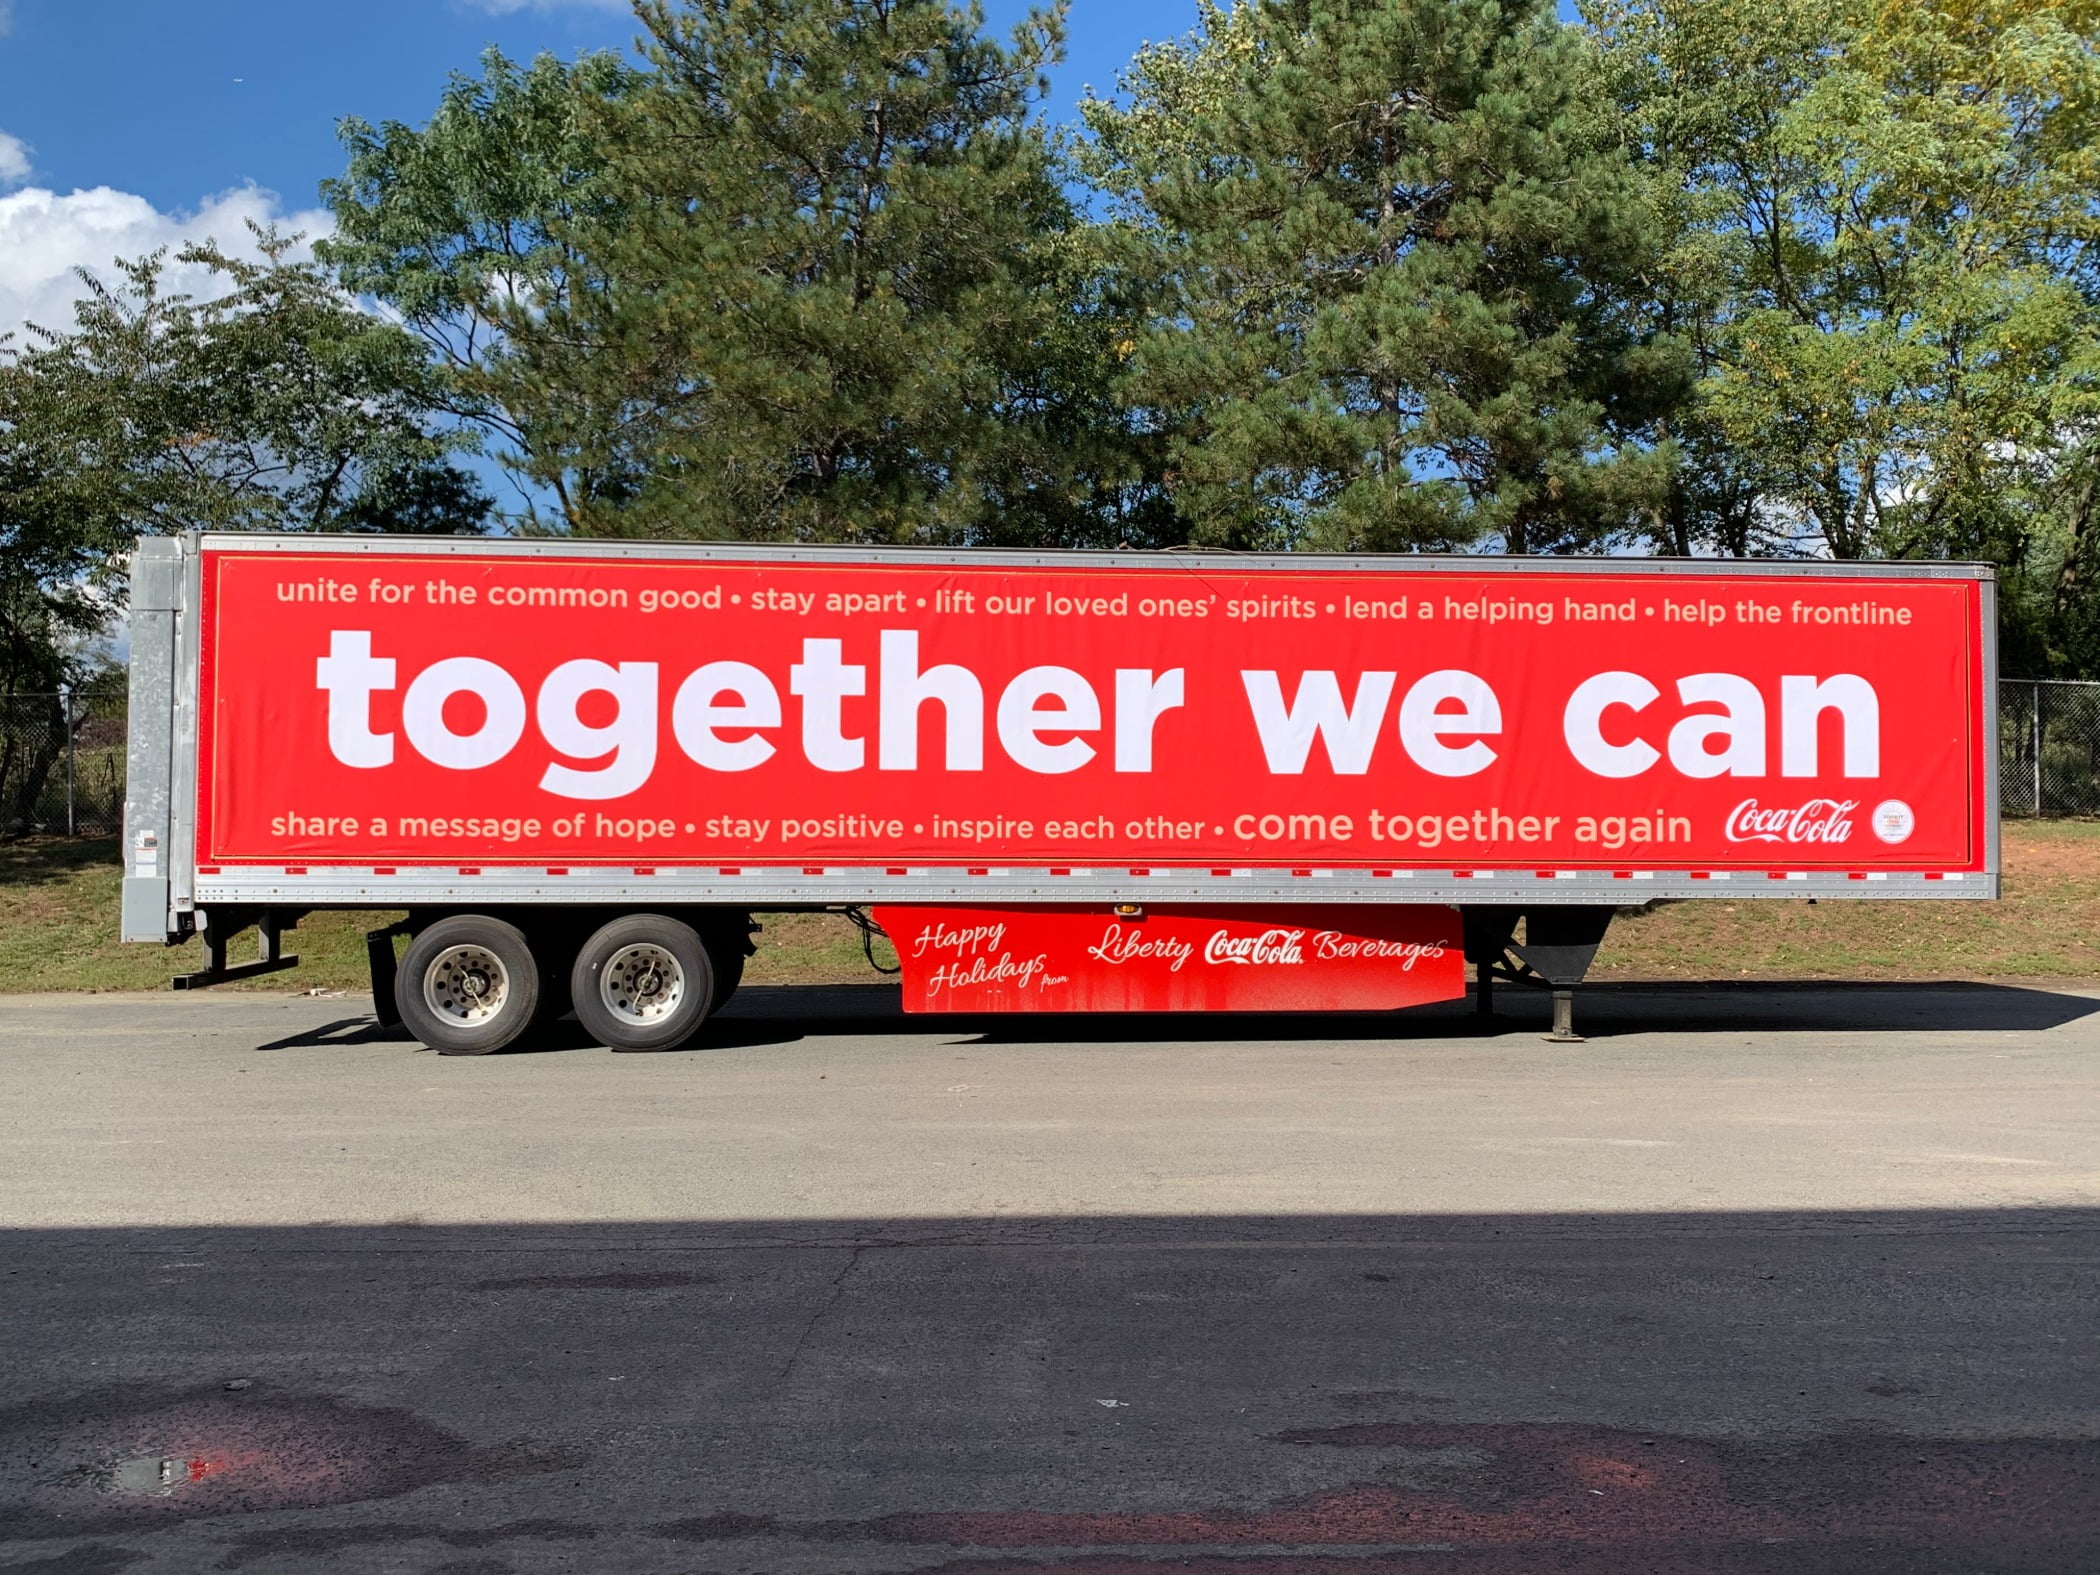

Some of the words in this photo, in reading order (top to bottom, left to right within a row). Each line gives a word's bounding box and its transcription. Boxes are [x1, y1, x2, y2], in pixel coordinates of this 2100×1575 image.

[277, 577, 358, 603] unite
[369, 577, 416, 604] for
[426, 579, 477, 605] the
[487, 586, 628, 609] common
[639, 584, 722, 613] good
[751, 587, 816, 616] stay
[825, 590, 907, 617] apart
[935, 589, 975, 614] lift
[985, 595, 1036, 616] our
[1046, 591, 1128, 616] loved
[1138, 594, 1216, 618] ones’
[1226, 594, 1316, 622] spirits
[1345, 595, 1407, 619] lend
[1417, 601, 1434, 620] a
[1444, 596, 1554, 625] helping
[1564, 597, 1636, 621] hand
[1664, 598, 1726, 627] help
[1735, 599, 1782, 624] the
[1791, 600, 1912, 625] frontline
[316, 630, 1184, 800] together
[1240, 670, 1502, 778] we
[1564, 671, 1880, 779] can
[271, 810, 359, 837] share
[369, 817, 388, 837] a
[399, 817, 541, 842] message
[552, 812, 586, 838] of
[595, 812, 676, 842] hope
[705, 815, 771, 843] stay
[781, 813, 904, 843] positive
[933, 814, 1034, 843] inspire
[1044, 815, 1115, 839] each
[1125, 815, 1206, 840] other
[1233, 813, 1354, 841] come
[1368, 807, 1561, 848] together
[1574, 808, 1691, 849] again
[1725, 798, 1861, 843] Coca-Cola
[912, 923, 1006, 957] Happy
[1088, 924, 1194, 972] Liberty
[1313, 931, 1448, 971] Beverages
[927, 952, 1047, 997] Holidays
[1040, 974, 1069, 993] from
